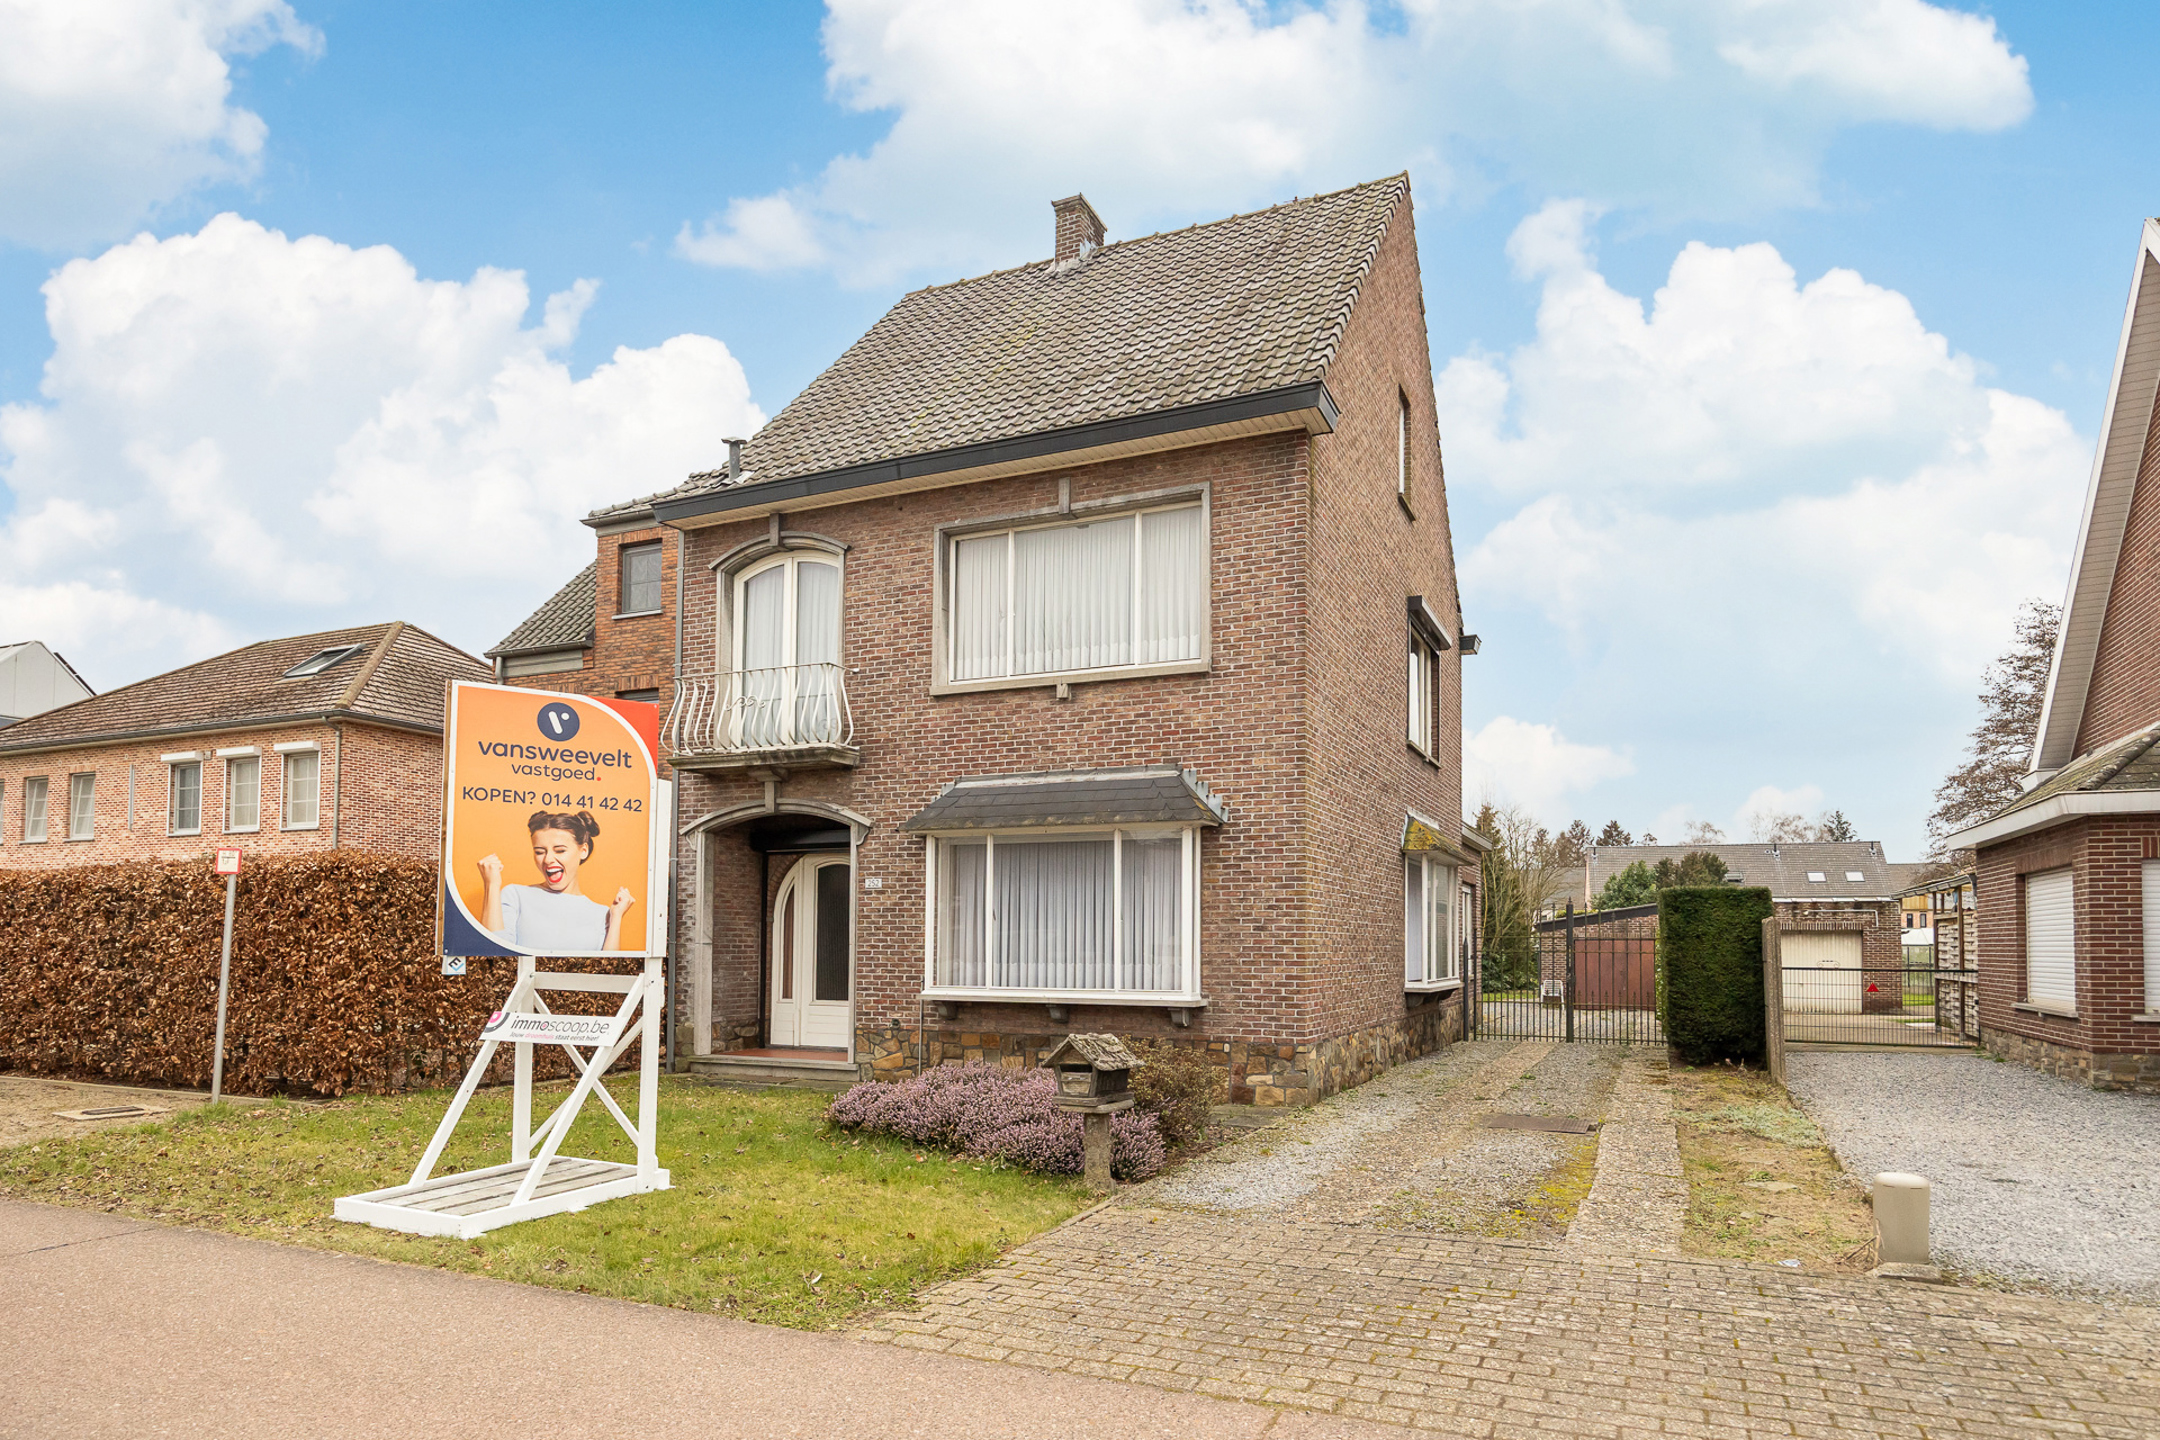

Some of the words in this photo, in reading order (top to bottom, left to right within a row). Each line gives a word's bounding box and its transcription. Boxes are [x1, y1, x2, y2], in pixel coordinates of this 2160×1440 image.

[478, 740, 632, 768] vansweevelt
[511, 763, 601, 781] vastgoed.
[463, 786, 536, 805] KOPEN?
[541, 792, 571, 807] 014
[576, 796, 594, 809] 41
[599, 797, 619, 811] 42
[623, 799, 642, 812] 42
[511, 1016, 610, 1035] immoscoop.be
